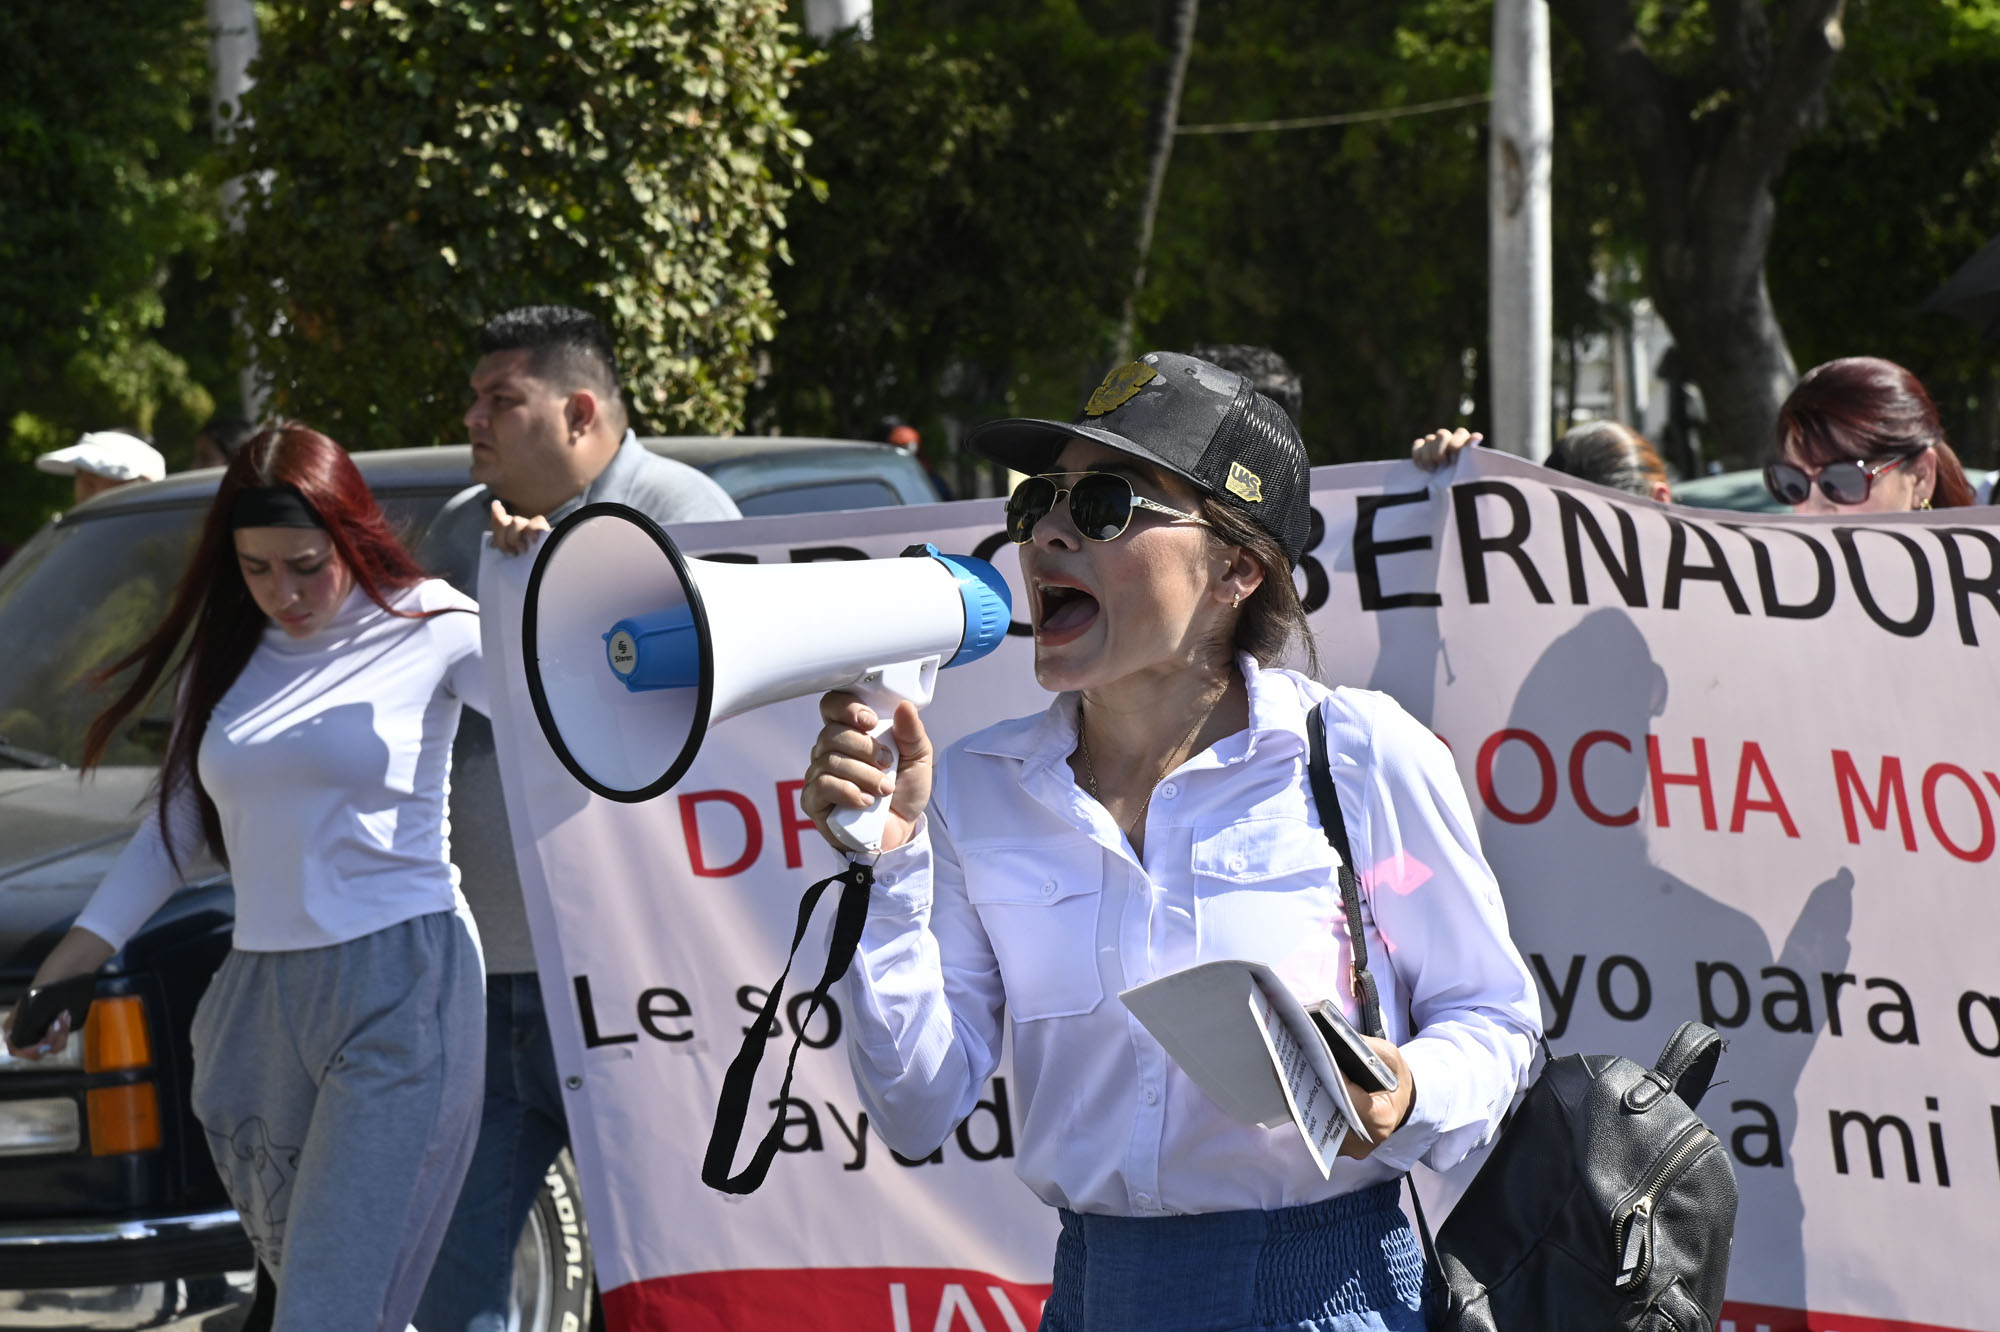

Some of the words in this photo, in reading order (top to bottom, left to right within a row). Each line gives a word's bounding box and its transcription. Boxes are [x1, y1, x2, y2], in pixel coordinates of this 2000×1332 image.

[1231, 464, 1259, 491] UAS
[972, 482, 2000, 648] BERNADOR
[1435, 728, 1801, 839] OCHA
[1831, 749, 2000, 864] MO
[574, 975, 694, 1049] Le
[1695, 959, 1921, 1047] para
[1829, 1097, 1951, 1188] mi
[545, 1163, 583, 1290] ADIAL
